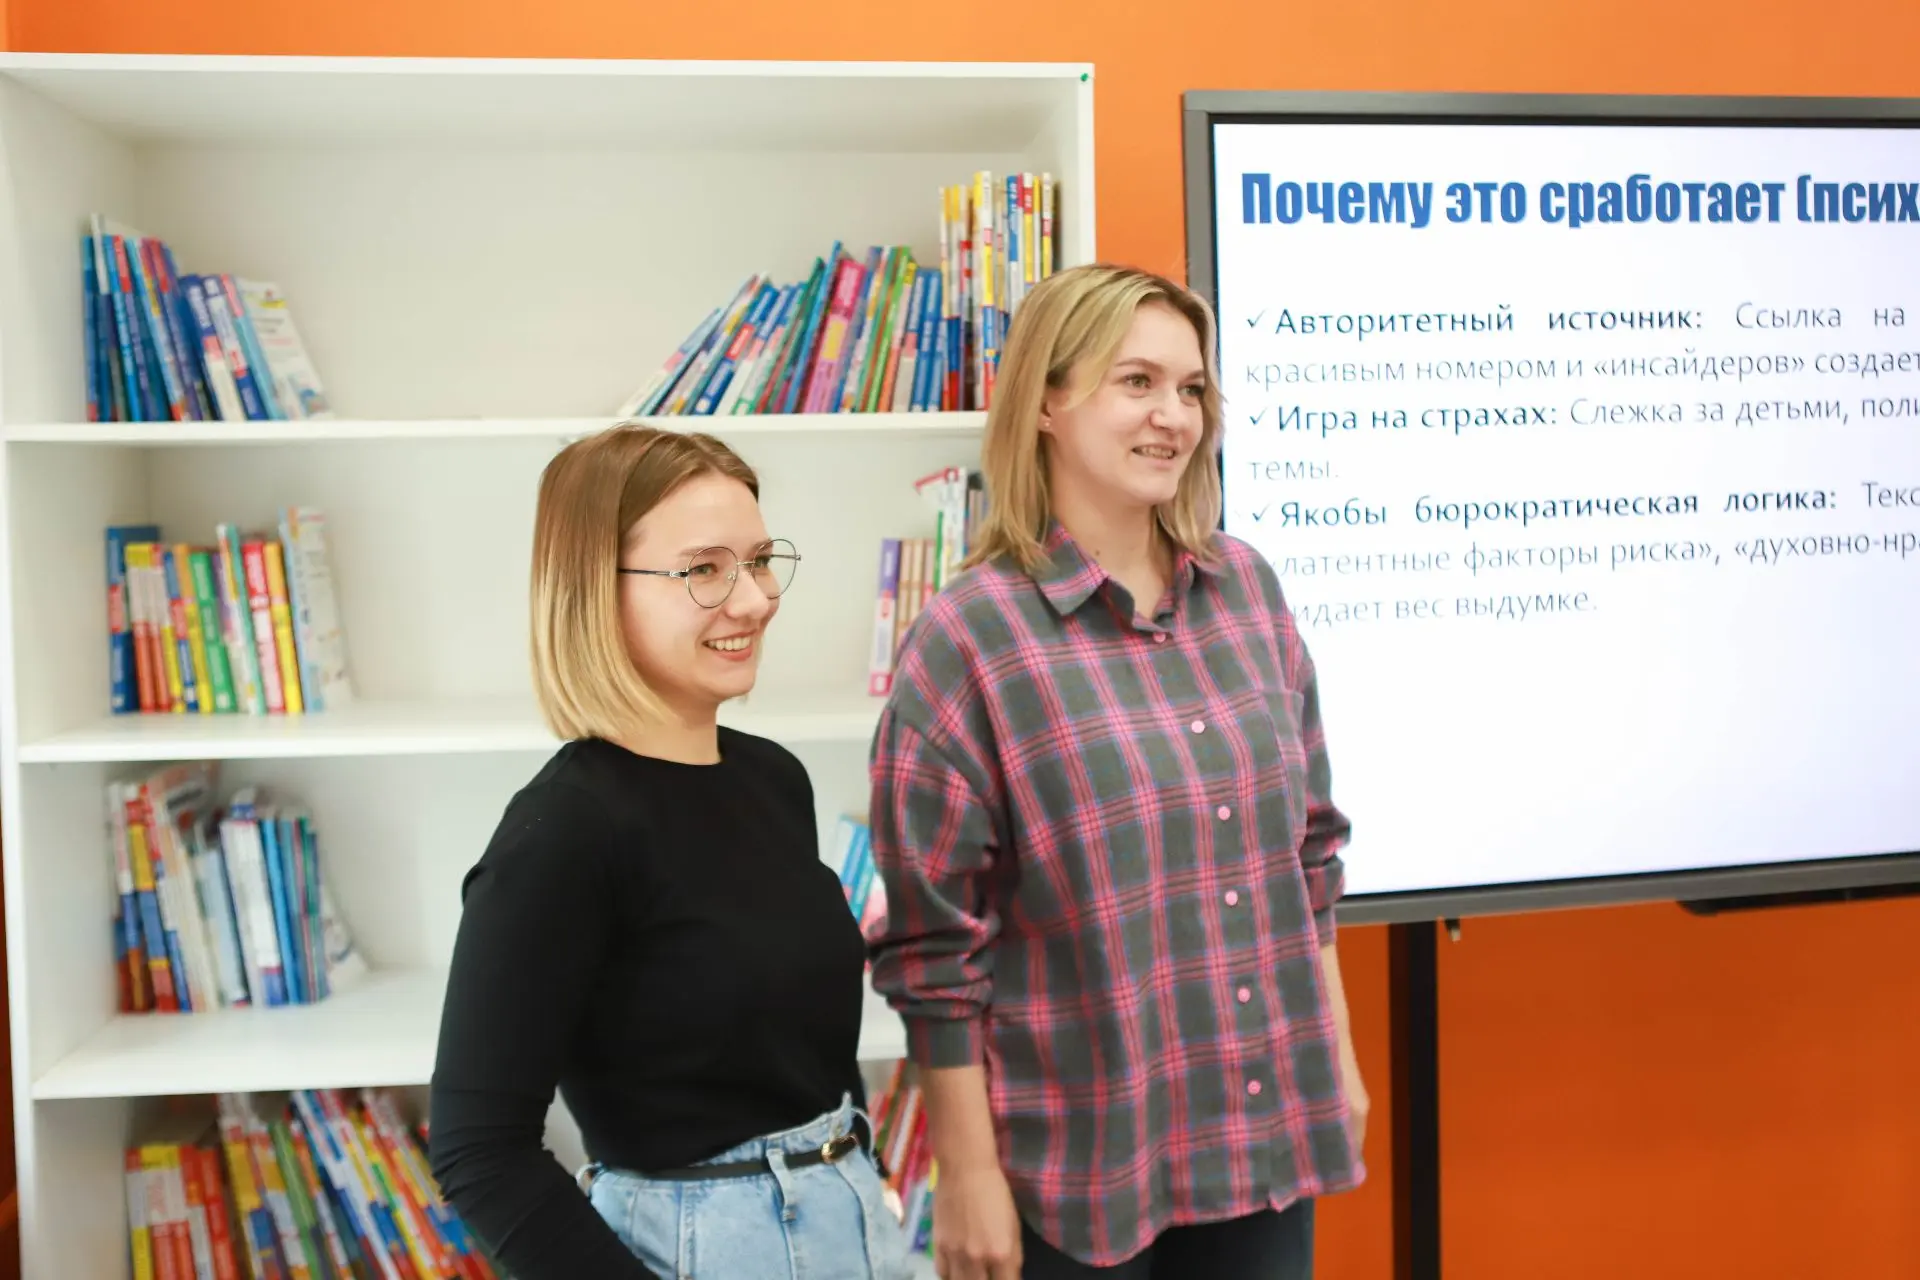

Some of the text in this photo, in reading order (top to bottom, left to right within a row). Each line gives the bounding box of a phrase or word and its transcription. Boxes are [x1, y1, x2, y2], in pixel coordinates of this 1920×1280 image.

[1240, 172, 1920, 230] Почему это сработает (псих
[1274, 301, 1906, 343] Авторитетный источник: Ссылка на
[1246, 361, 1405, 393] красивым
[1416, 359, 1556, 389] номером
[1566, 359, 1583, 379] и
[1593, 347, 1806, 384] «инсайдеров»
[1278, 405, 1358, 440] Игра
[1371, 409, 1408, 430] на
[1421, 406, 1557, 437] страхах:
[1570, 397, 1683, 426] Слежка
[1696, 401, 1725, 423] за
[1734, 399, 1849, 428] детьми,
[1247, 459, 1339, 482] темы.
[1280, 496, 1387, 528] Якобы
[1415, 494, 1699, 531] бюрократическая
[1723, 489, 1837, 513] логика:
[1271, 531, 1920, 578] латентные факторы риска», «духовно-нр
[1395, 598, 1444, 620] вес
[1455, 591, 1598, 623] выдумке.
